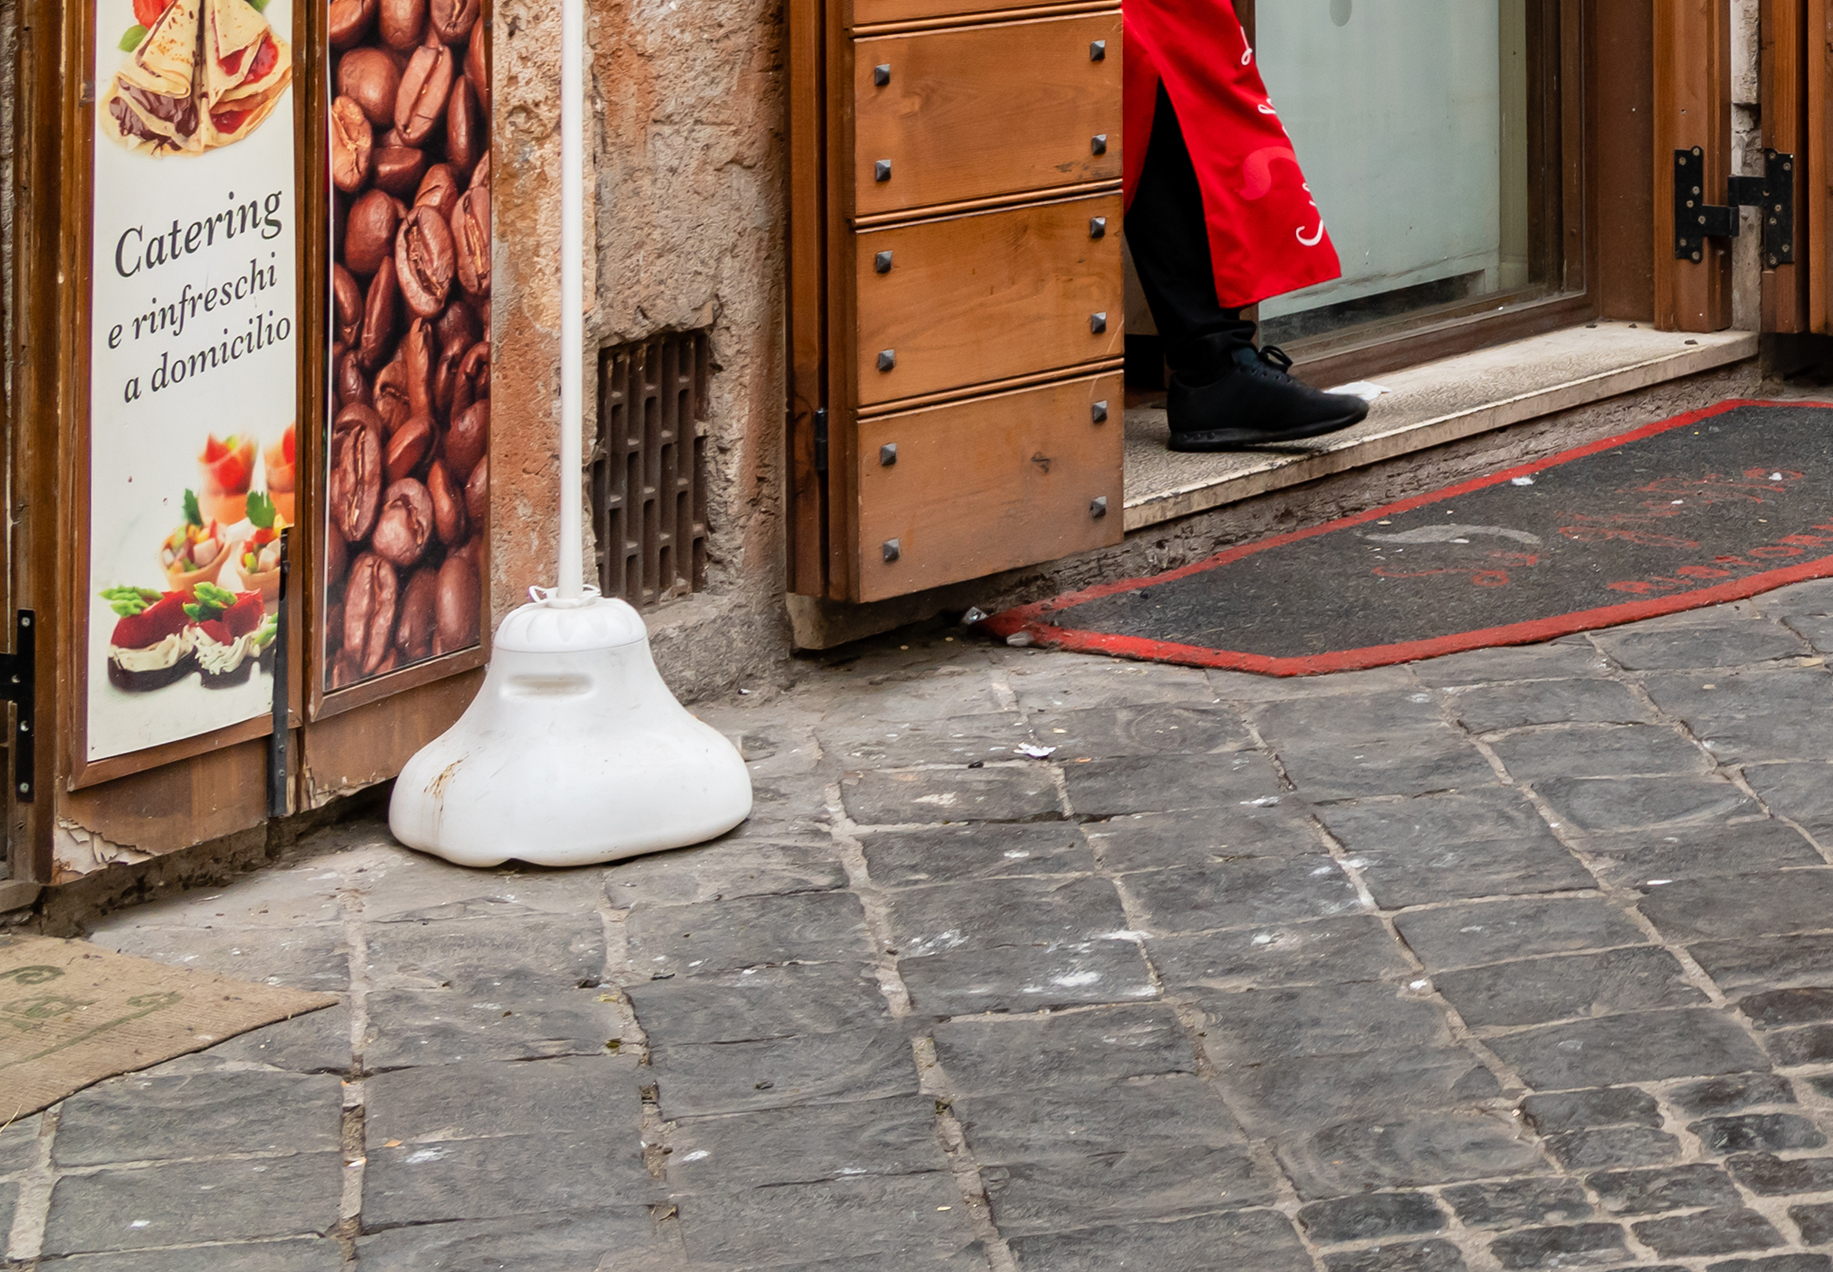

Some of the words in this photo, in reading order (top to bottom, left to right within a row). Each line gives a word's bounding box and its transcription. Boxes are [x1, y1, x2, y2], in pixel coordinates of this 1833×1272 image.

[115, 190, 283, 278] Catering
[108, 323, 123, 350] e
[132, 251, 278, 340] rinfreschi
[124, 375, 142, 404] a
[151, 309, 292, 393] domicilio
